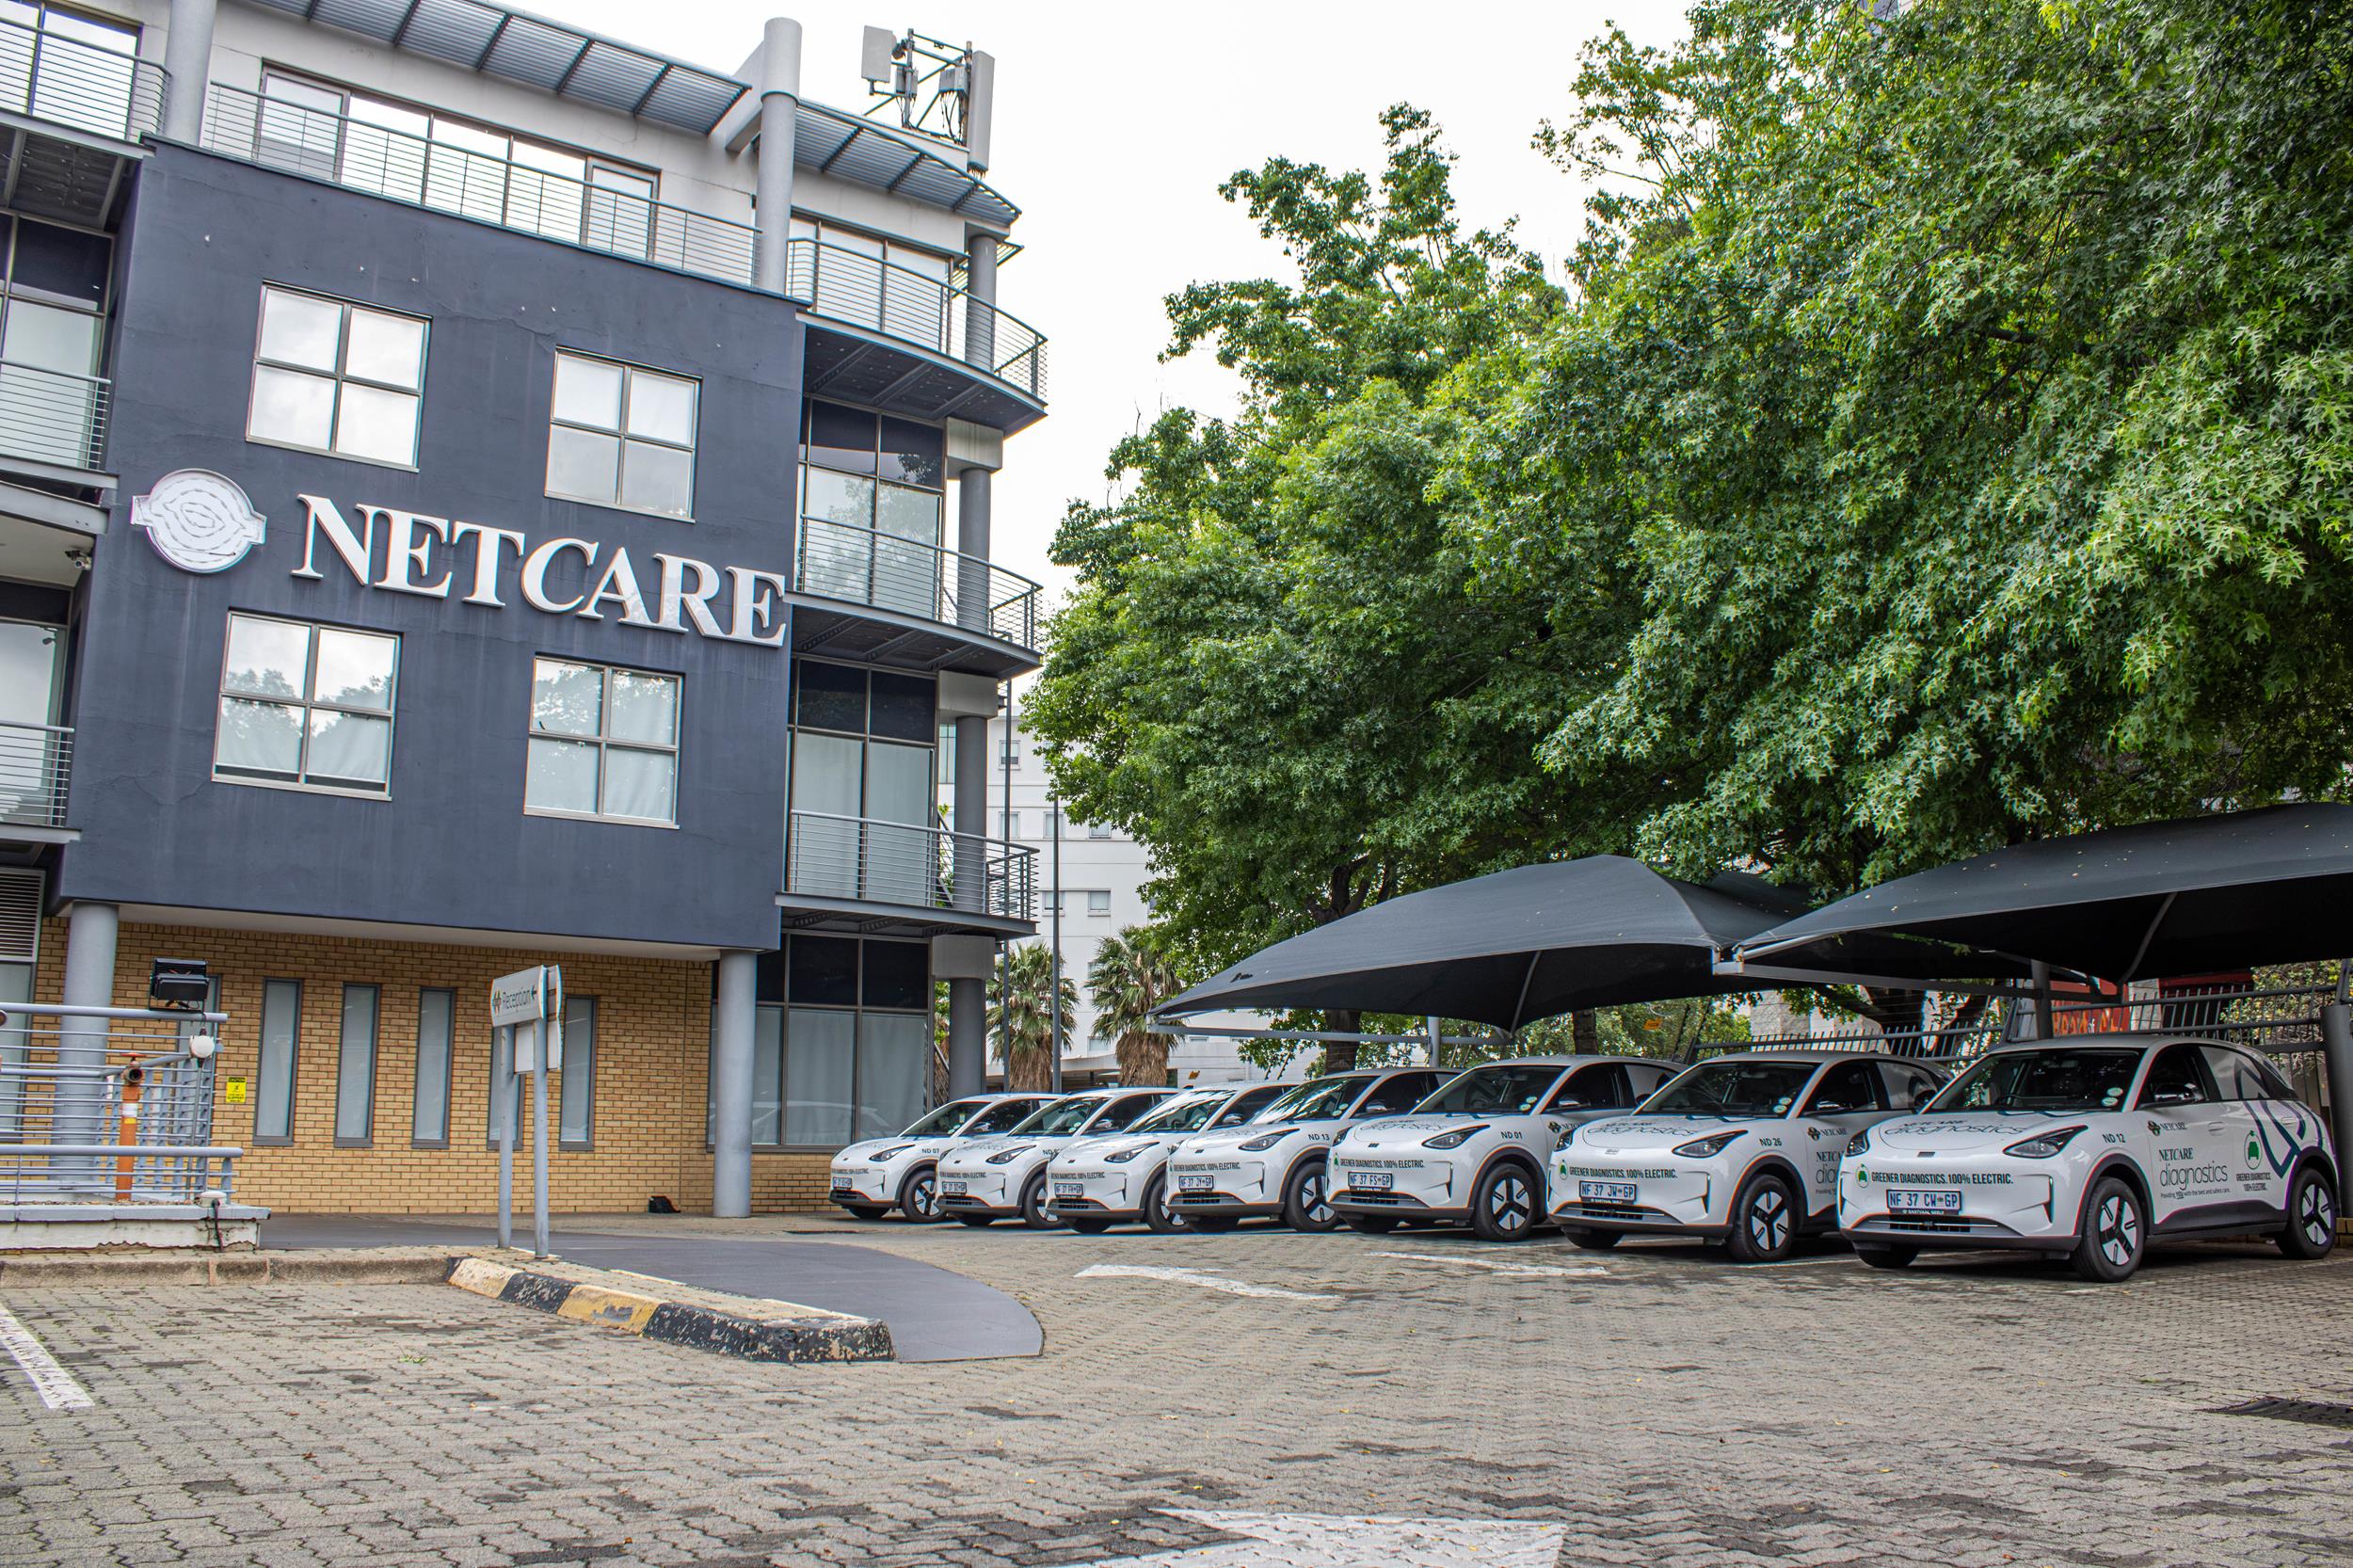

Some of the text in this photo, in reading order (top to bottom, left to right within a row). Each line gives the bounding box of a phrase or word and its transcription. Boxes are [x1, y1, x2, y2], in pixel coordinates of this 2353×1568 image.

[290, 493, 788, 648] NETCARE
[502, 986, 530, 1013] Reception
[1884, 1124, 2025, 1136] diagnostics
[2160, 1121, 2187, 1130] NETCARE
[1759, 1138, 1783, 1146] ND 26
[2103, 1133, 2125, 1143] ND 12
[1816, 1150, 1843, 1162] NETCA
[2158, 1147, 2194, 1161] NETCARE
[1219, 1161, 1241, 1171] ELECTRIC.
[1340, 1159, 1355, 1167] GREENER
[1384, 1160, 1398, 1168] 100%
[1398, 1160, 1425, 1169] ELECTRIC.
[1570, 1166, 1590, 1176] GREENER
[1626, 1169, 1643, 1178] 100%
[1644, 1169, 1678, 1178] ELECTRIC.
[1871, 1171, 2014, 1185] GREENER DIAGNOSTICS. 100% ELECTRIC.
[2159, 1160, 2228, 1192] diagnostics
[1350, 1174, 1356, 1184] NF
[1360, 1175, 1367, 1185] 37
[1382, 1175, 1390, 1186] GP
[1582, 1184, 1634, 1198] NF 37 JW GP
[1890, 1192, 1958, 1208] NF 37 CW GP
